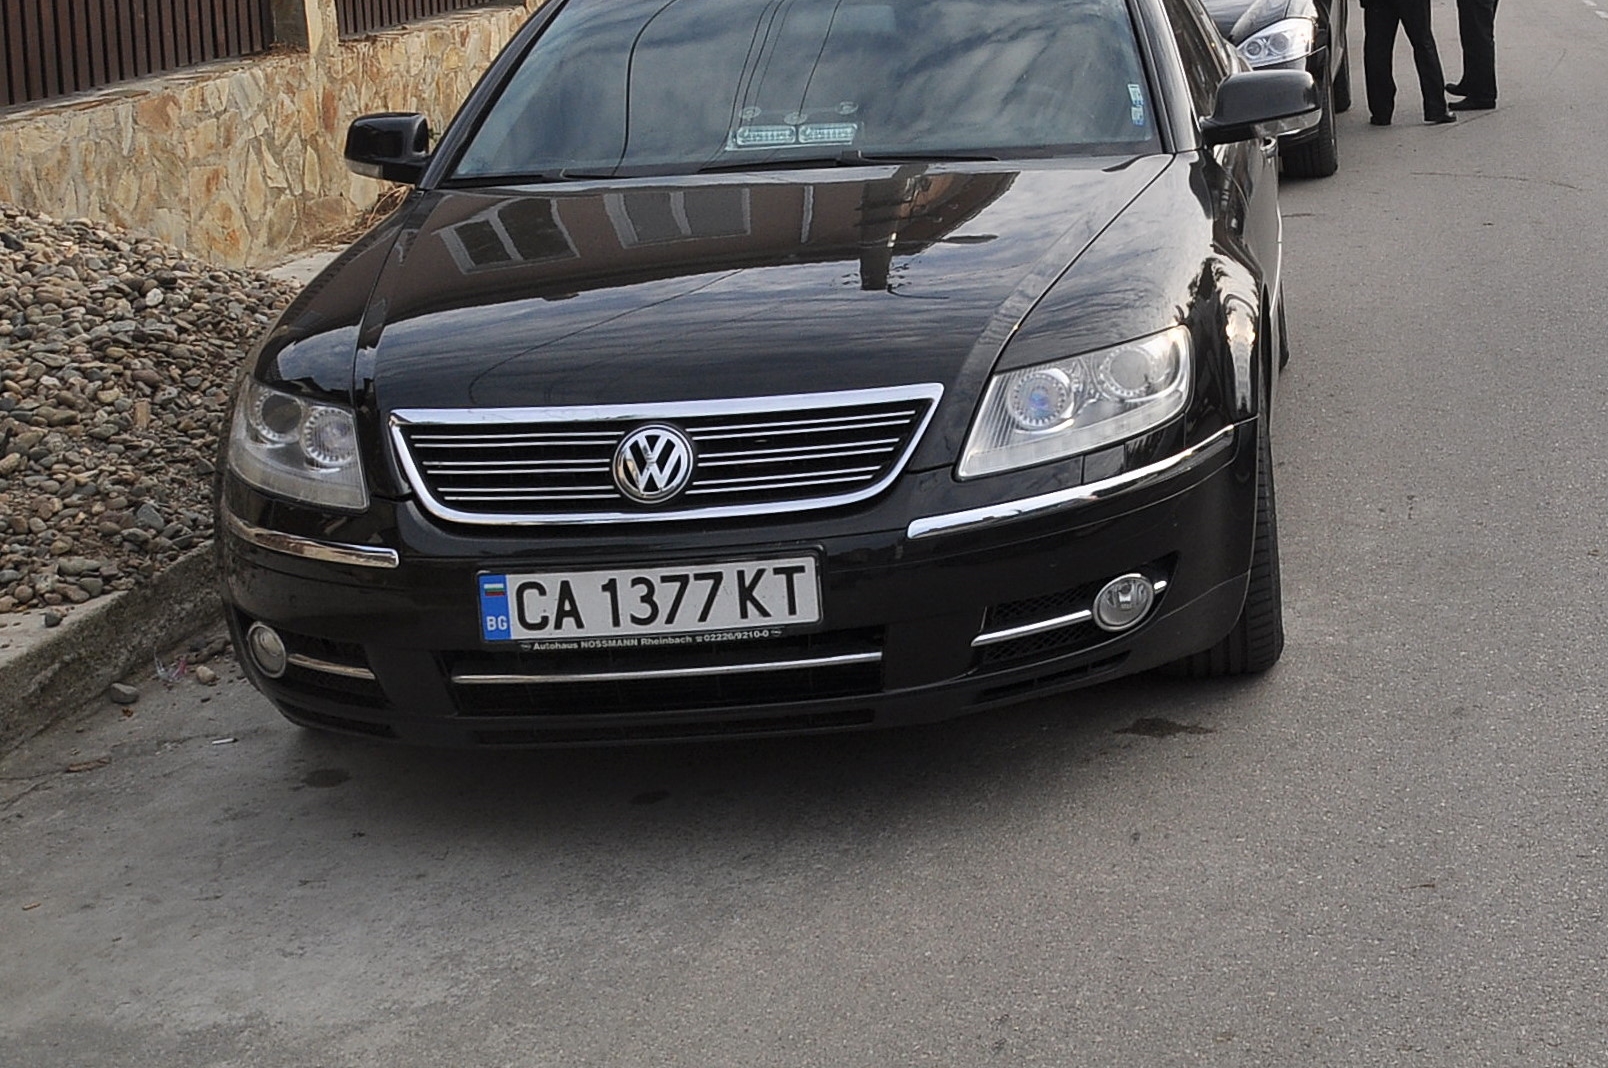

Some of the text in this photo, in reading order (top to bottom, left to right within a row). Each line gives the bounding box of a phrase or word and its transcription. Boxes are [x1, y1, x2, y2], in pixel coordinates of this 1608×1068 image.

[612, 424, 693, 504] VW
[515, 565, 806, 631] CA 1377 KT
[487, 616, 508, 632] BG
[533, 641, 579, 651] Autohaus
[640, 635, 692, 646] Rheinbach
